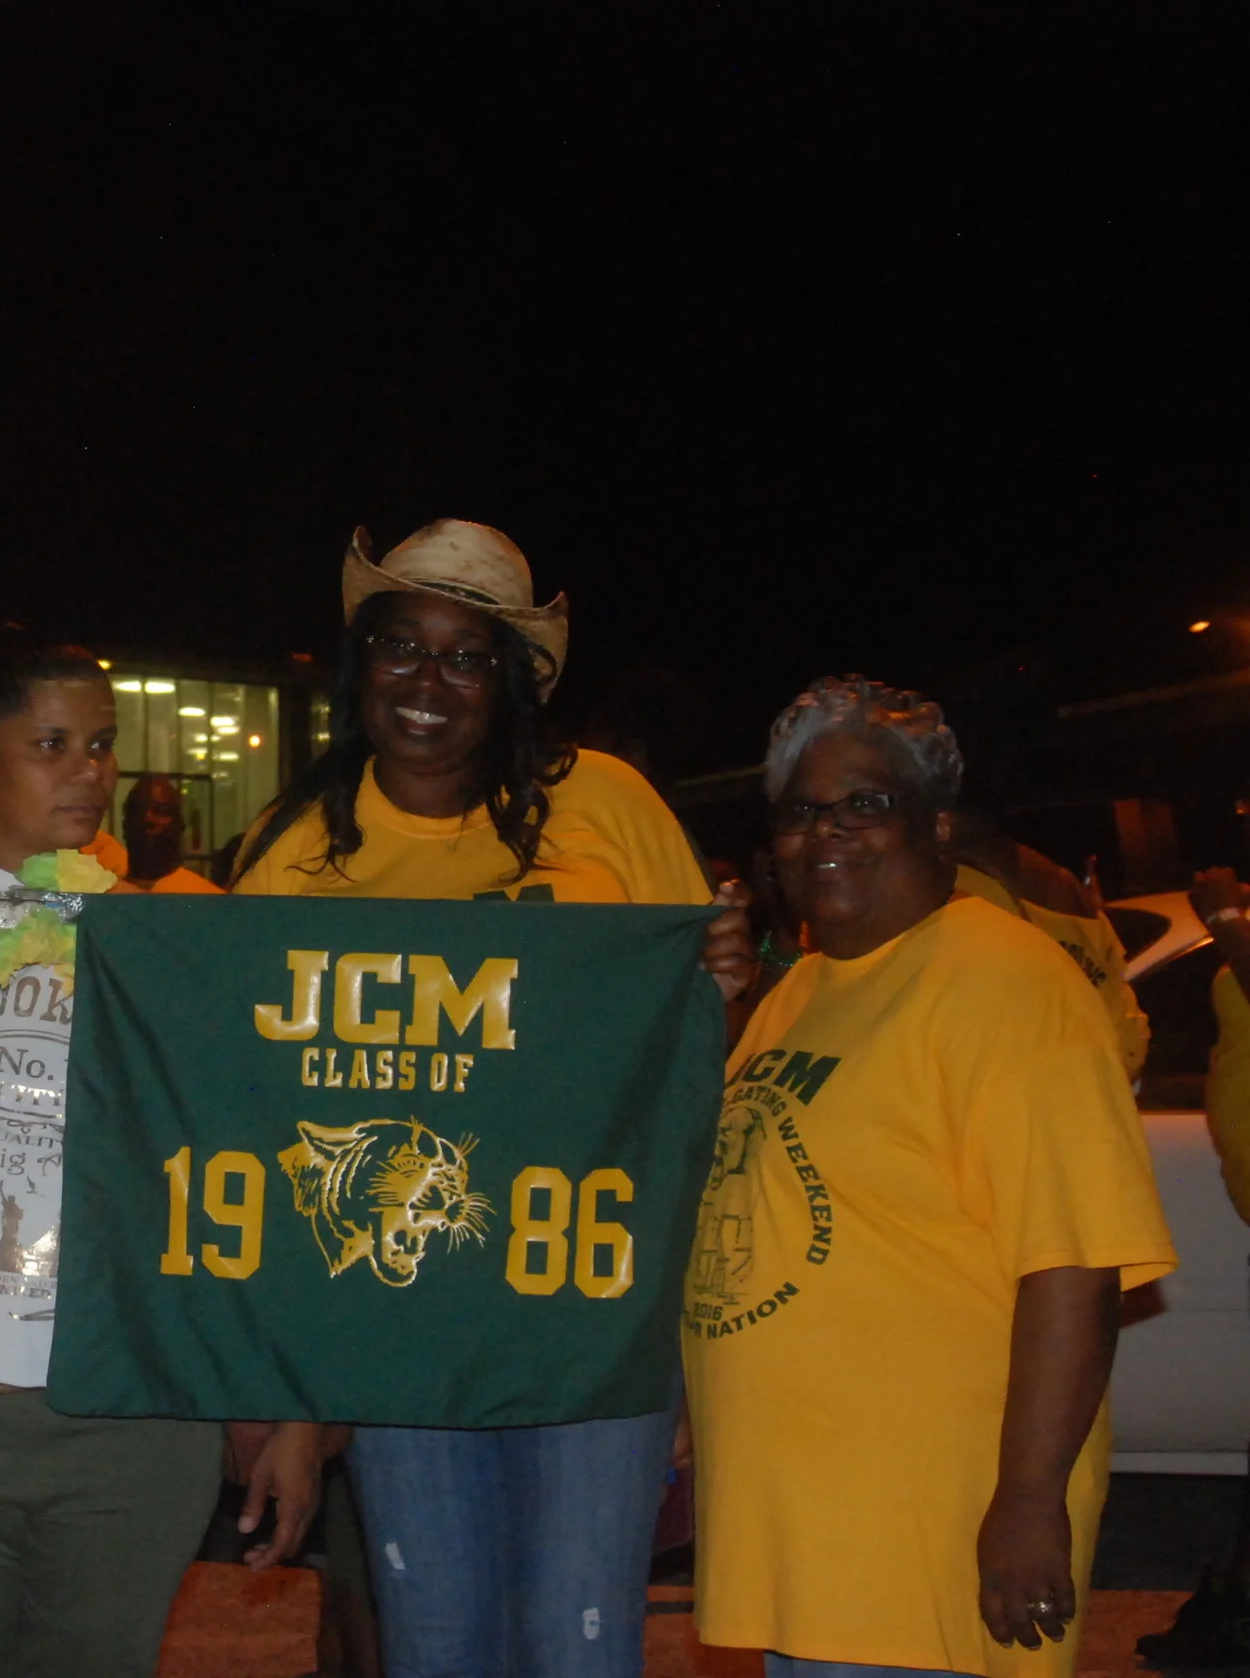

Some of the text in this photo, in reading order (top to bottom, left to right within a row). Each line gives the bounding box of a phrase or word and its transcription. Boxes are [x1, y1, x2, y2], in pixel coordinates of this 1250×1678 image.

[254, 949, 519, 1051] JCM
[301, 1047, 475, 1093] CLASS OF
[160, 1145, 634, 1299] 19 86
[777, 1115, 833, 1266] WEEKEND
[692, 1301, 724, 1322] 2016
[706, 1281, 800, 1340] NATION
